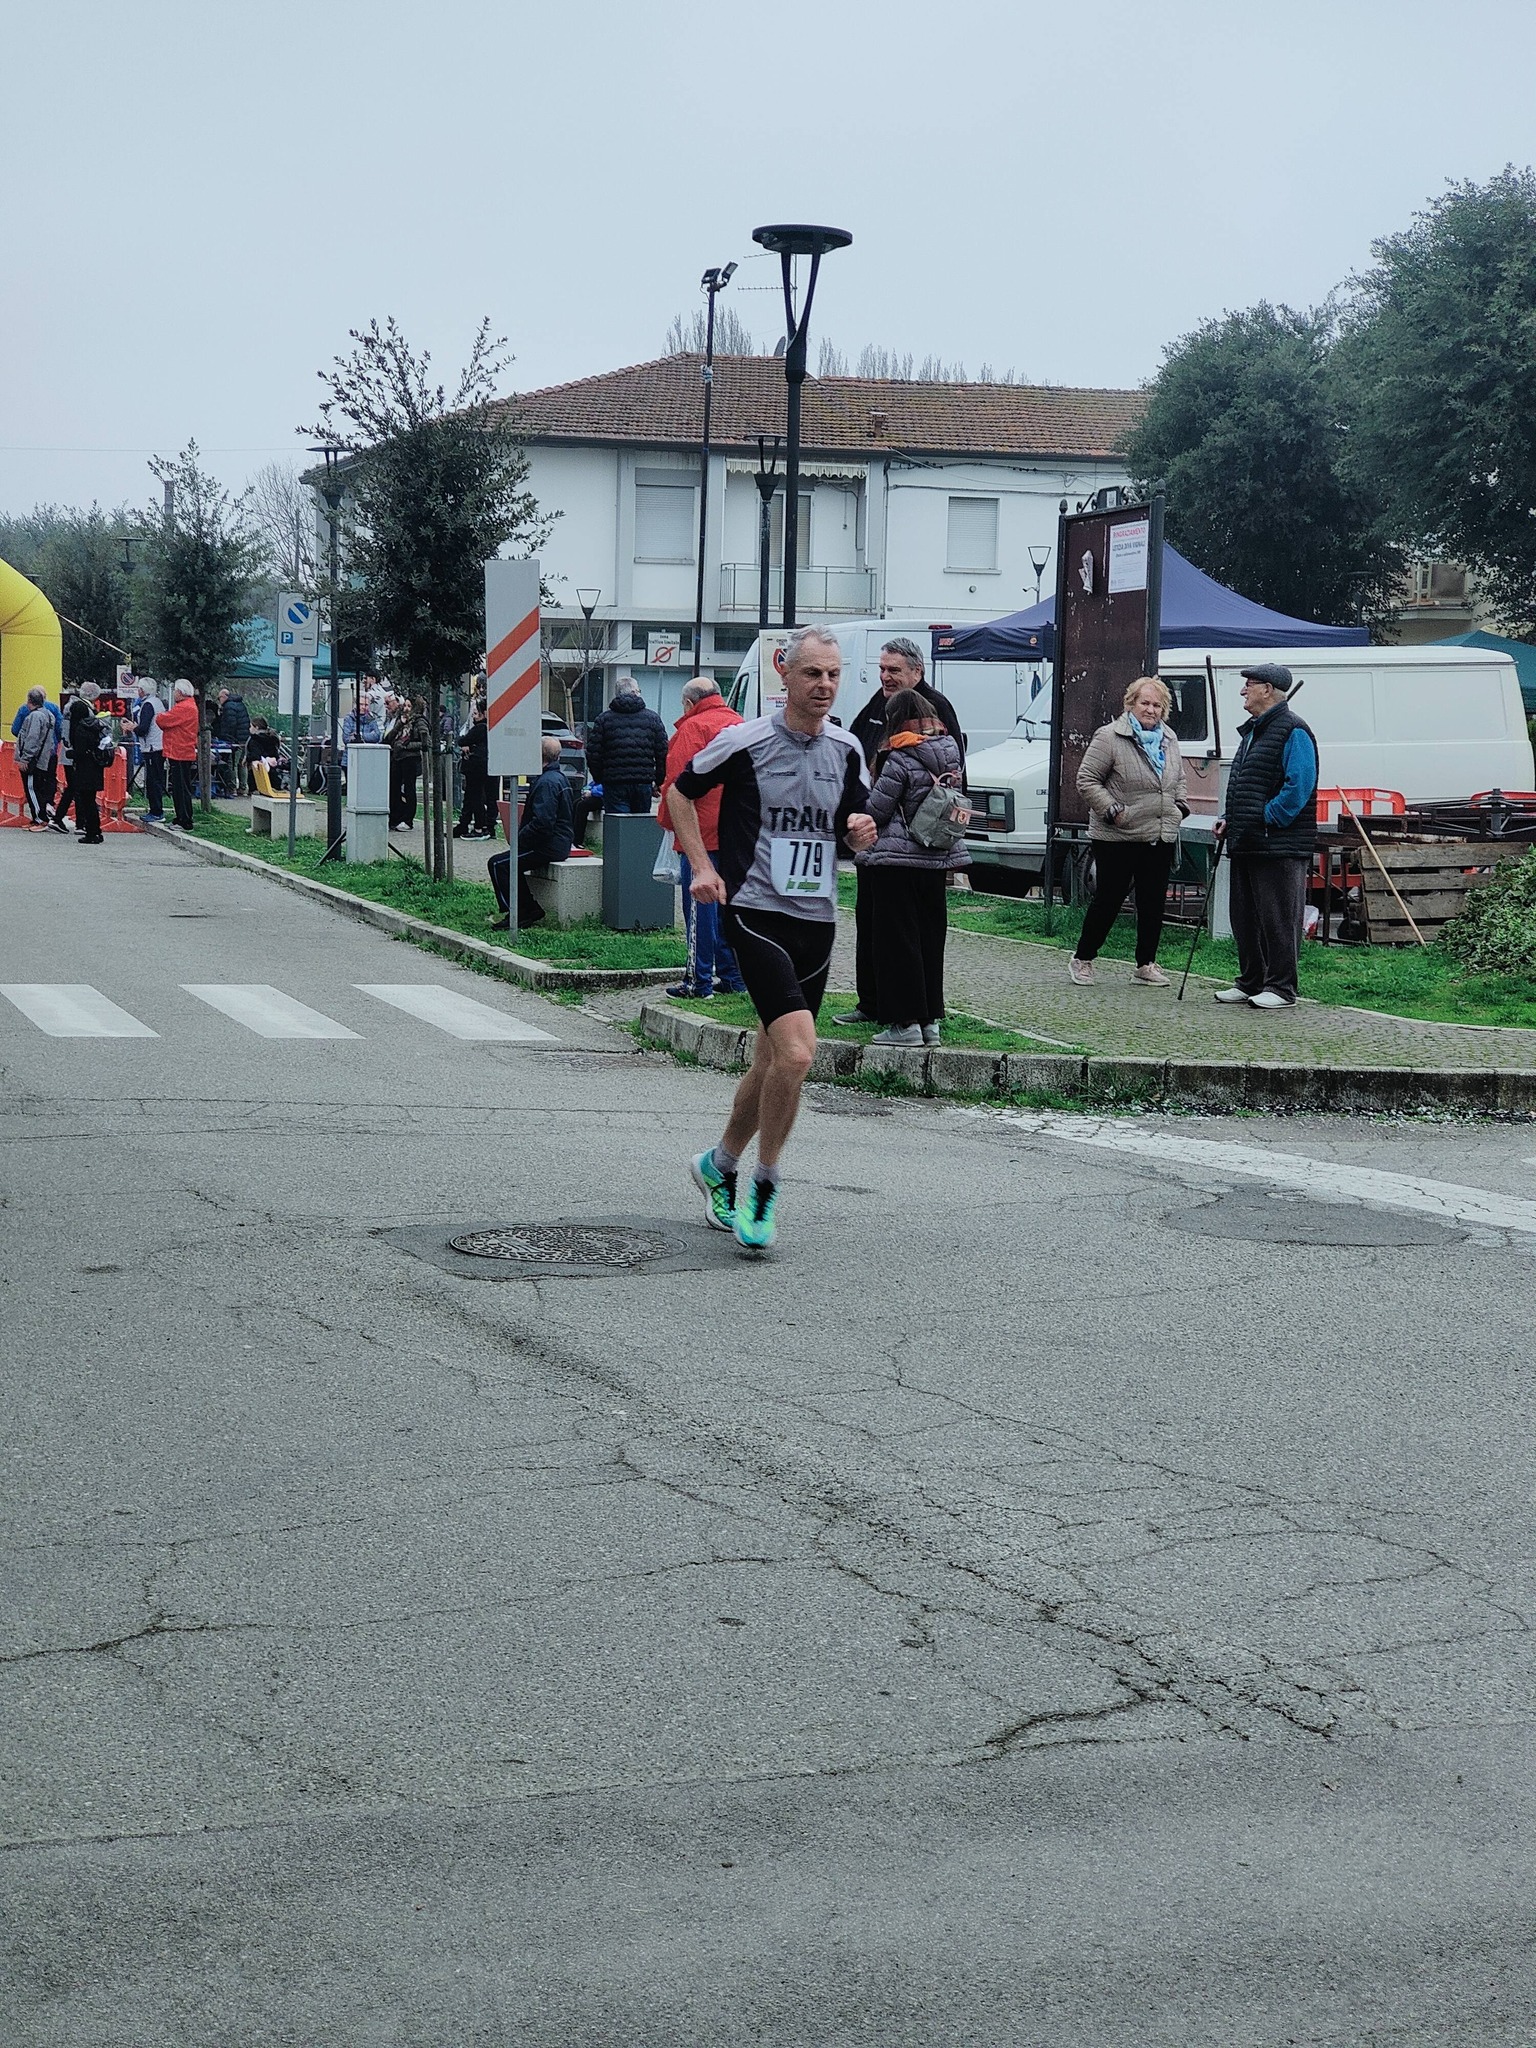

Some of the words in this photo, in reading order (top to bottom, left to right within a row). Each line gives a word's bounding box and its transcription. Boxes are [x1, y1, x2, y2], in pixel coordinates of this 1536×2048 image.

[283, 632, 291, 643] P
[768, 806, 835, 834] TRAIL
[789, 841, 823, 877] 779
